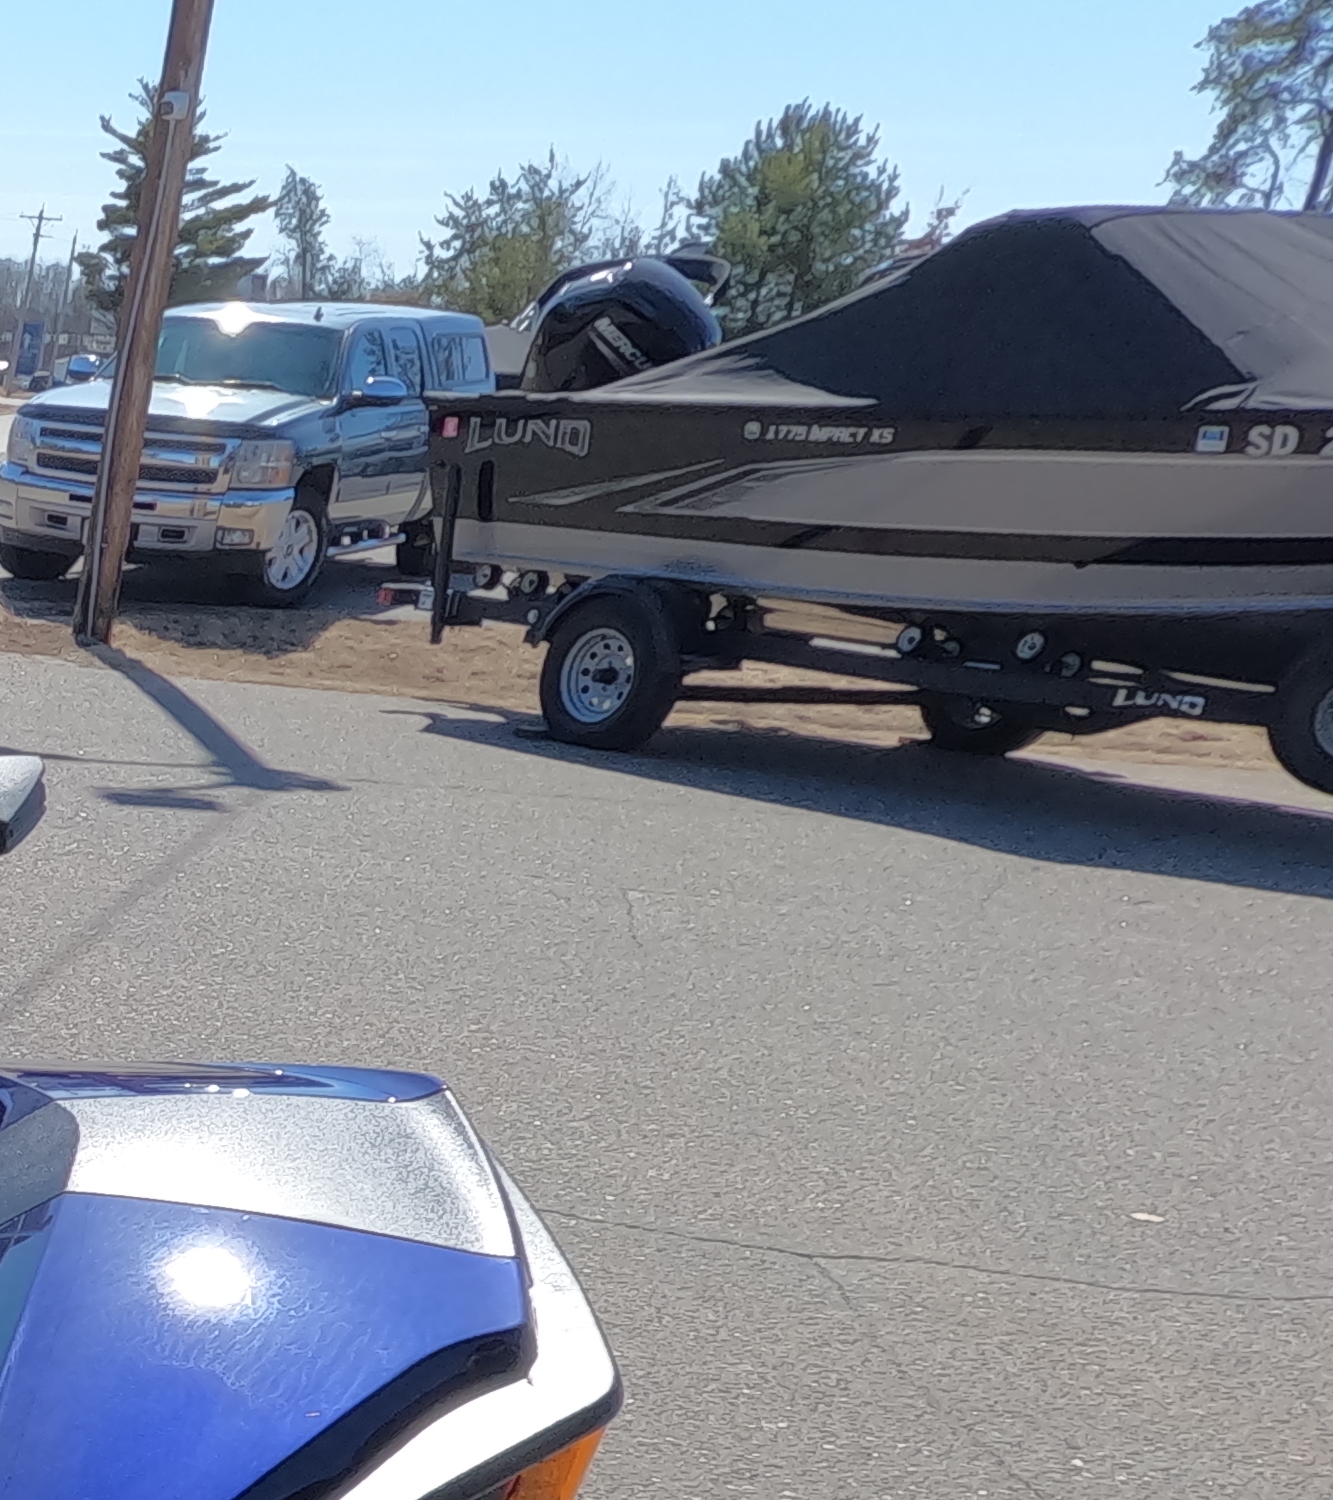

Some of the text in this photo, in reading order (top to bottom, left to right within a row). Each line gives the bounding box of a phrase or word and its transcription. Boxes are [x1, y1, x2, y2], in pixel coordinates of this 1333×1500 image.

[464, 416, 591, 457] LUND
[869, 427, 895, 444] XS
[1245, 424, 1300, 457] SD
[1112, 688, 1206, 715] LUND
